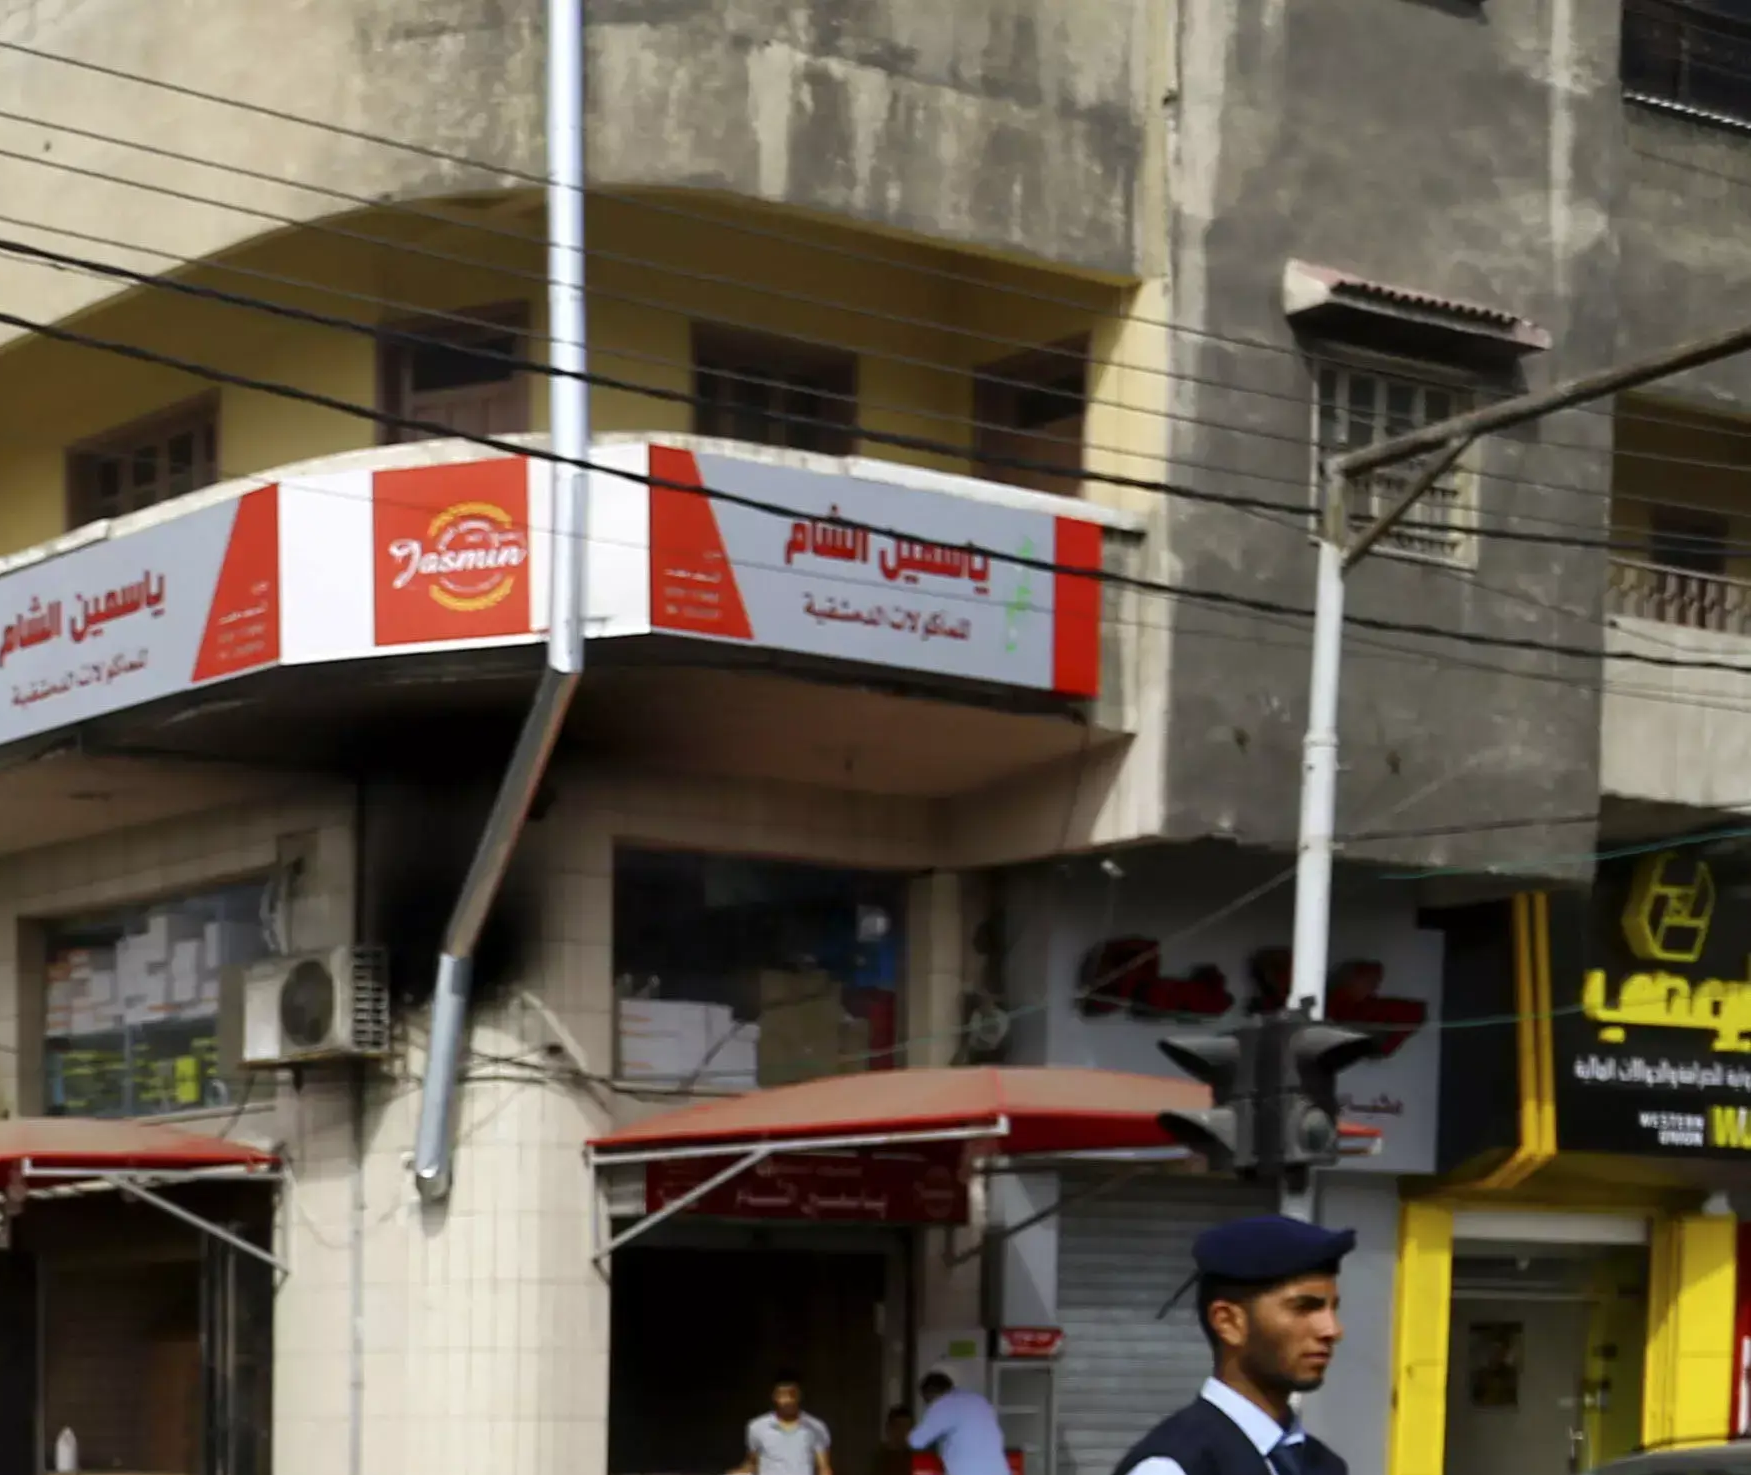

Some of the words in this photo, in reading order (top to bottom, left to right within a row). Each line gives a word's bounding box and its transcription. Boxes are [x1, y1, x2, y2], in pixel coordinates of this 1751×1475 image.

[388, 538, 528, 589] Jasmin
[69, 569, 166, 643] ياسمين
[1639, 1111, 1704, 1129] WESTERN
